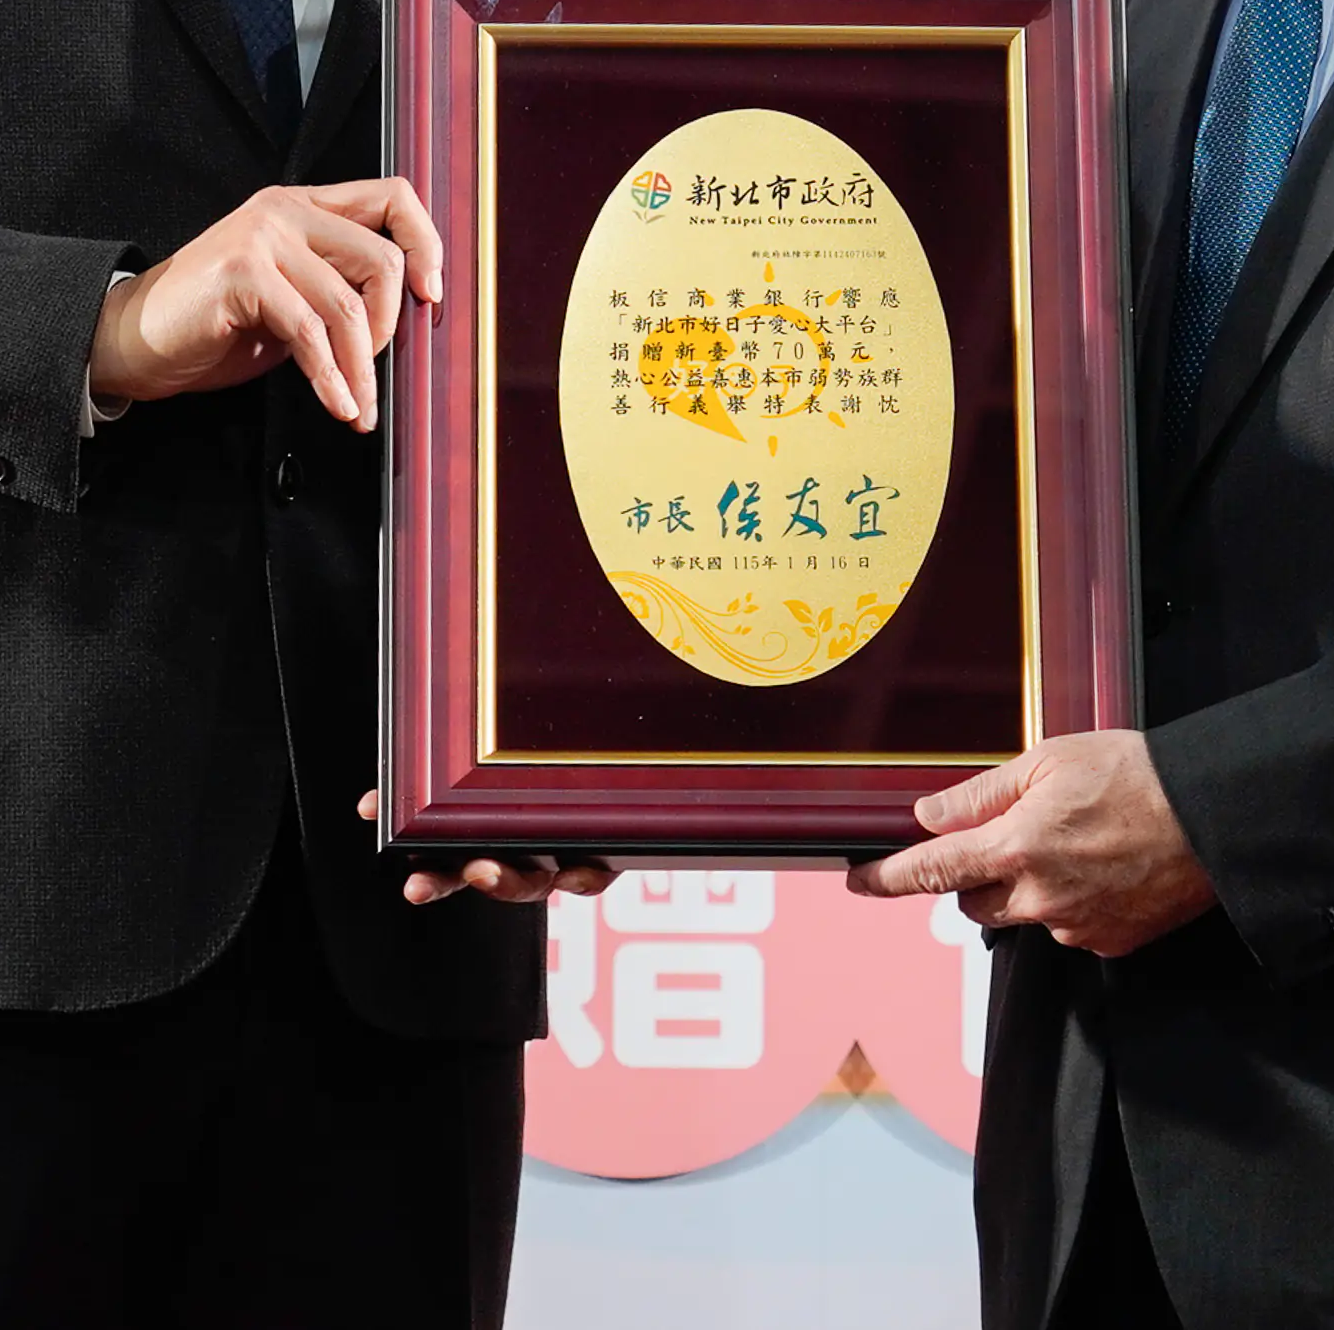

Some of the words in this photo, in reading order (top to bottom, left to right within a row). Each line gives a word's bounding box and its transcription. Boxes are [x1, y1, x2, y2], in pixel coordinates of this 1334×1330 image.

[685, 172, 875, 212] 新北市政府
[689, 215, 717, 225] New
[722, 215, 763, 228] Taipei
[767, 215, 795, 228] City
[800, 215, 879, 225] Government
[609, 287, 901, 309] 板信商業銀行響應
[617, 313, 895, 337] 「新北市好日子愛心大平台」
[610, 368, 903, 389] 熱心公益嘉惠本市弱勢族群
[610, 393, 900, 415] 善行義舉特表謝忱
[620, 495, 695, 535] 市長
[716, 474, 901, 543] 侯友宜
